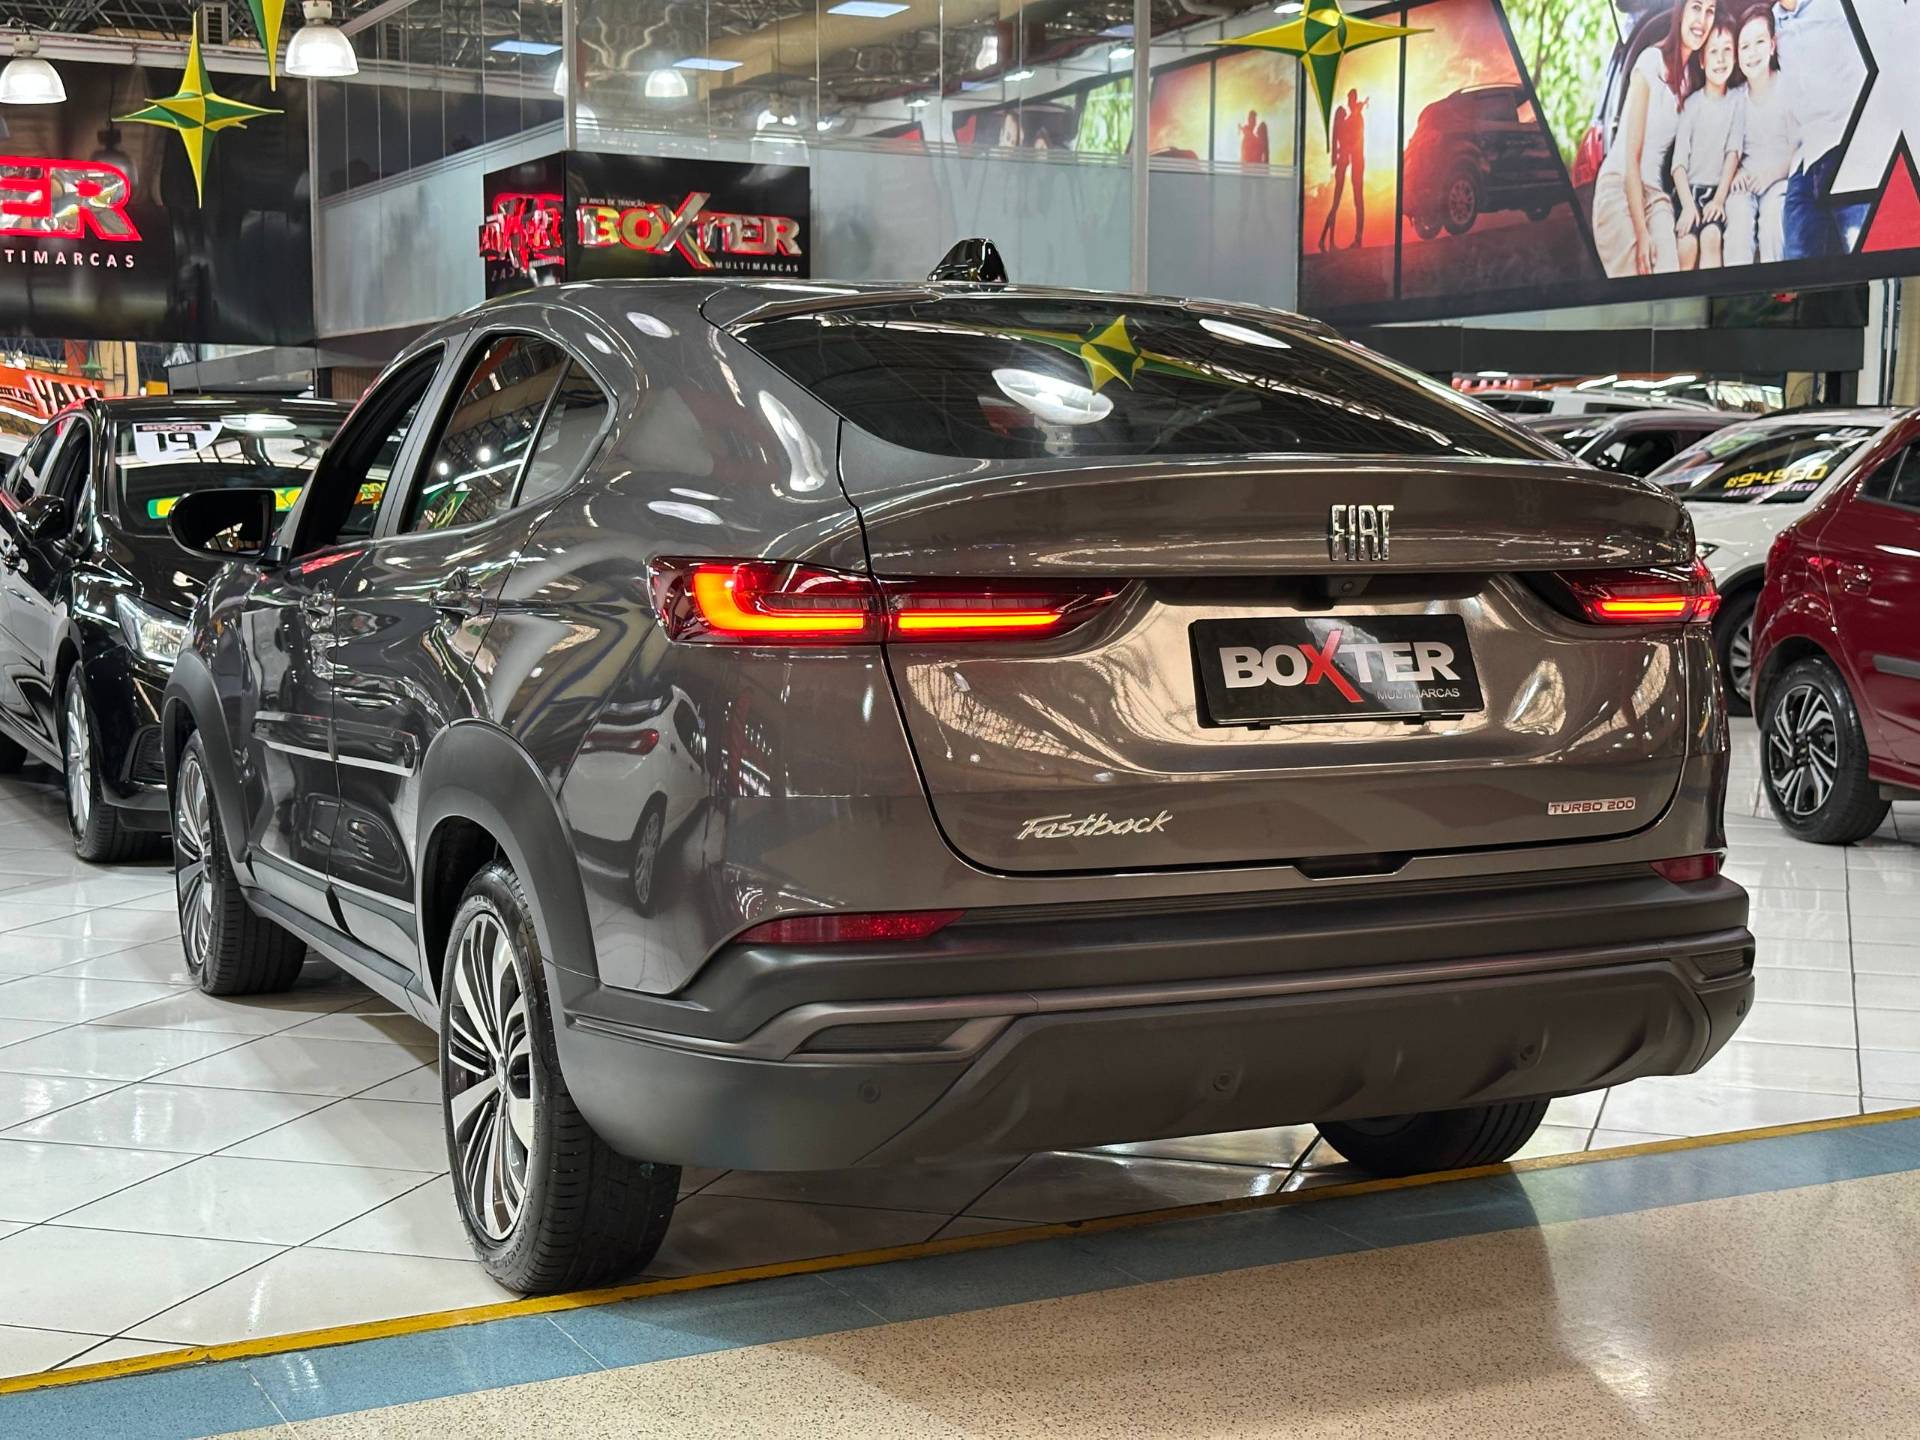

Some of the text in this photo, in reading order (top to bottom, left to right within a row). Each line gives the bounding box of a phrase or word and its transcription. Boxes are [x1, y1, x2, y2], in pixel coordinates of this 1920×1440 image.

[576, 192, 802, 270] BOXTER
[715, 261, 799, 272] MULTIMARCAS
[1330, 504, 1395, 561] FIAT
[1219, 628, 1461, 703] BOXTER
[1377, 687, 1460, 700] MULTIMARCAS
[1551, 799, 1634, 813] TURBO 200
[1016, 809, 1173, 840] Fastback
